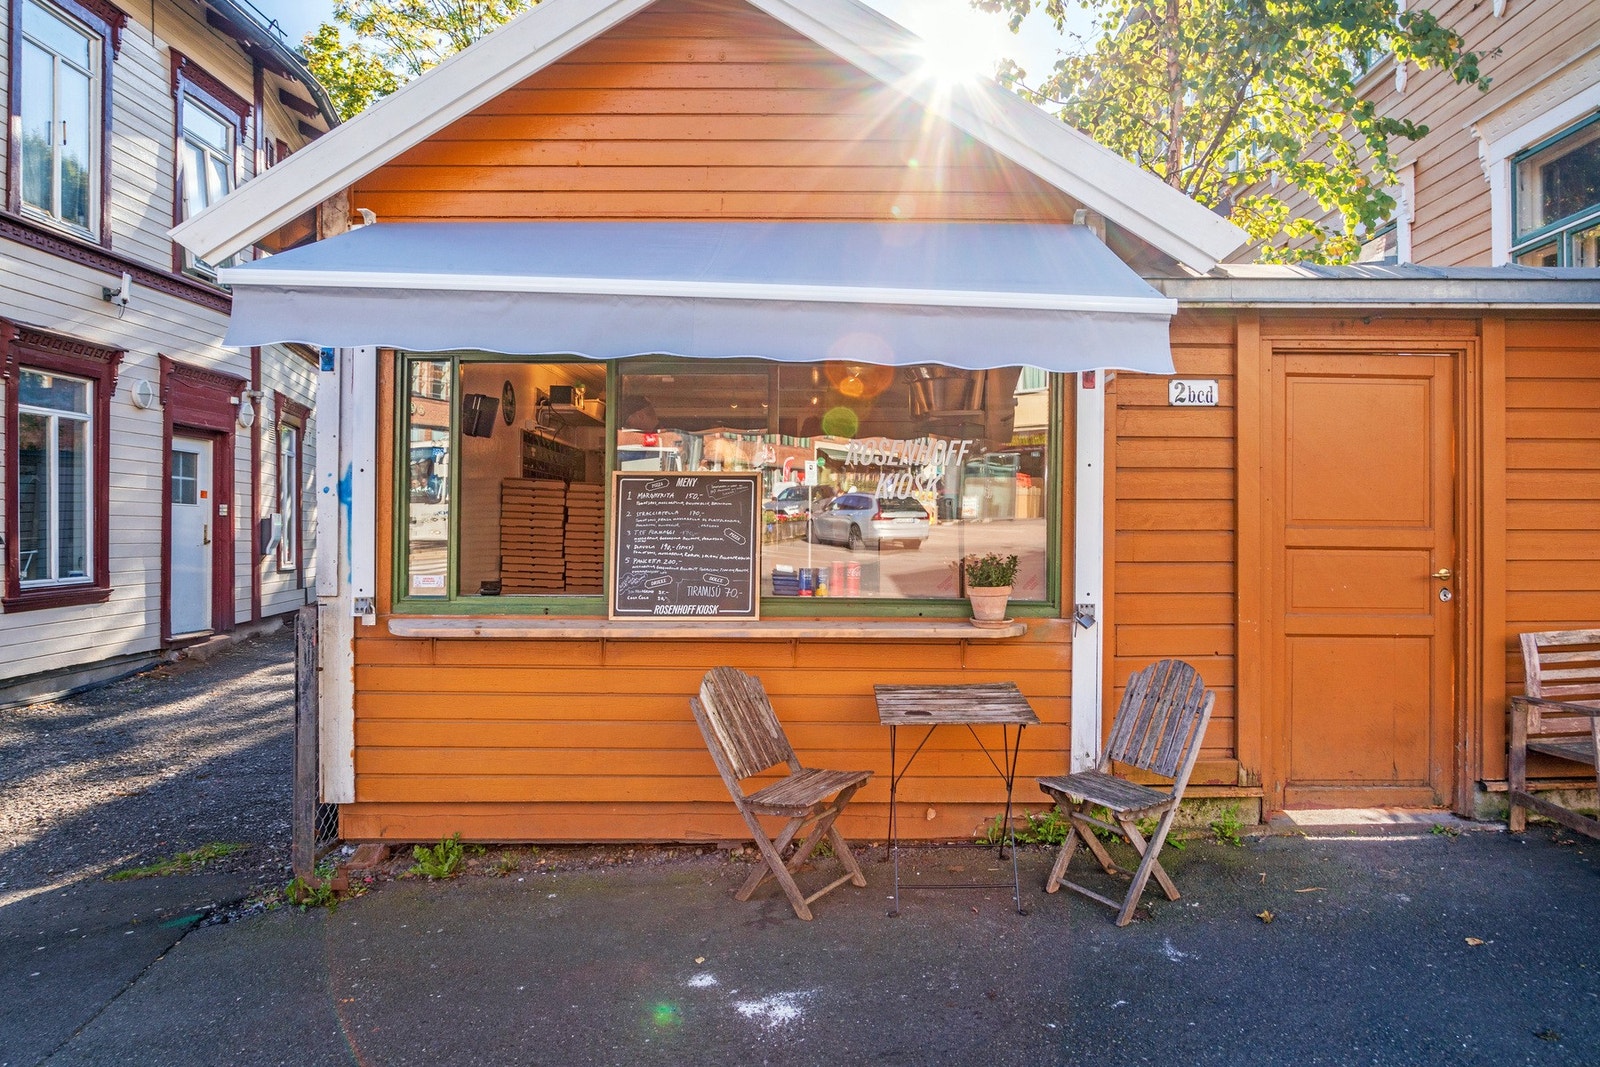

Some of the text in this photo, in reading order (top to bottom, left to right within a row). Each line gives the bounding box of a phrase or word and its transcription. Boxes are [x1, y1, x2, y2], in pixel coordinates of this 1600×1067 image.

[845, 439, 973, 467] ROSENHOFF
[675, 477, 699, 487] MENY
[875, 472, 945, 500] KIOSK
[626, 491, 632, 501] 1
[624, 556, 631, 564] 5
[653, 604, 720, 615] ROSENHOFF KIOSK
